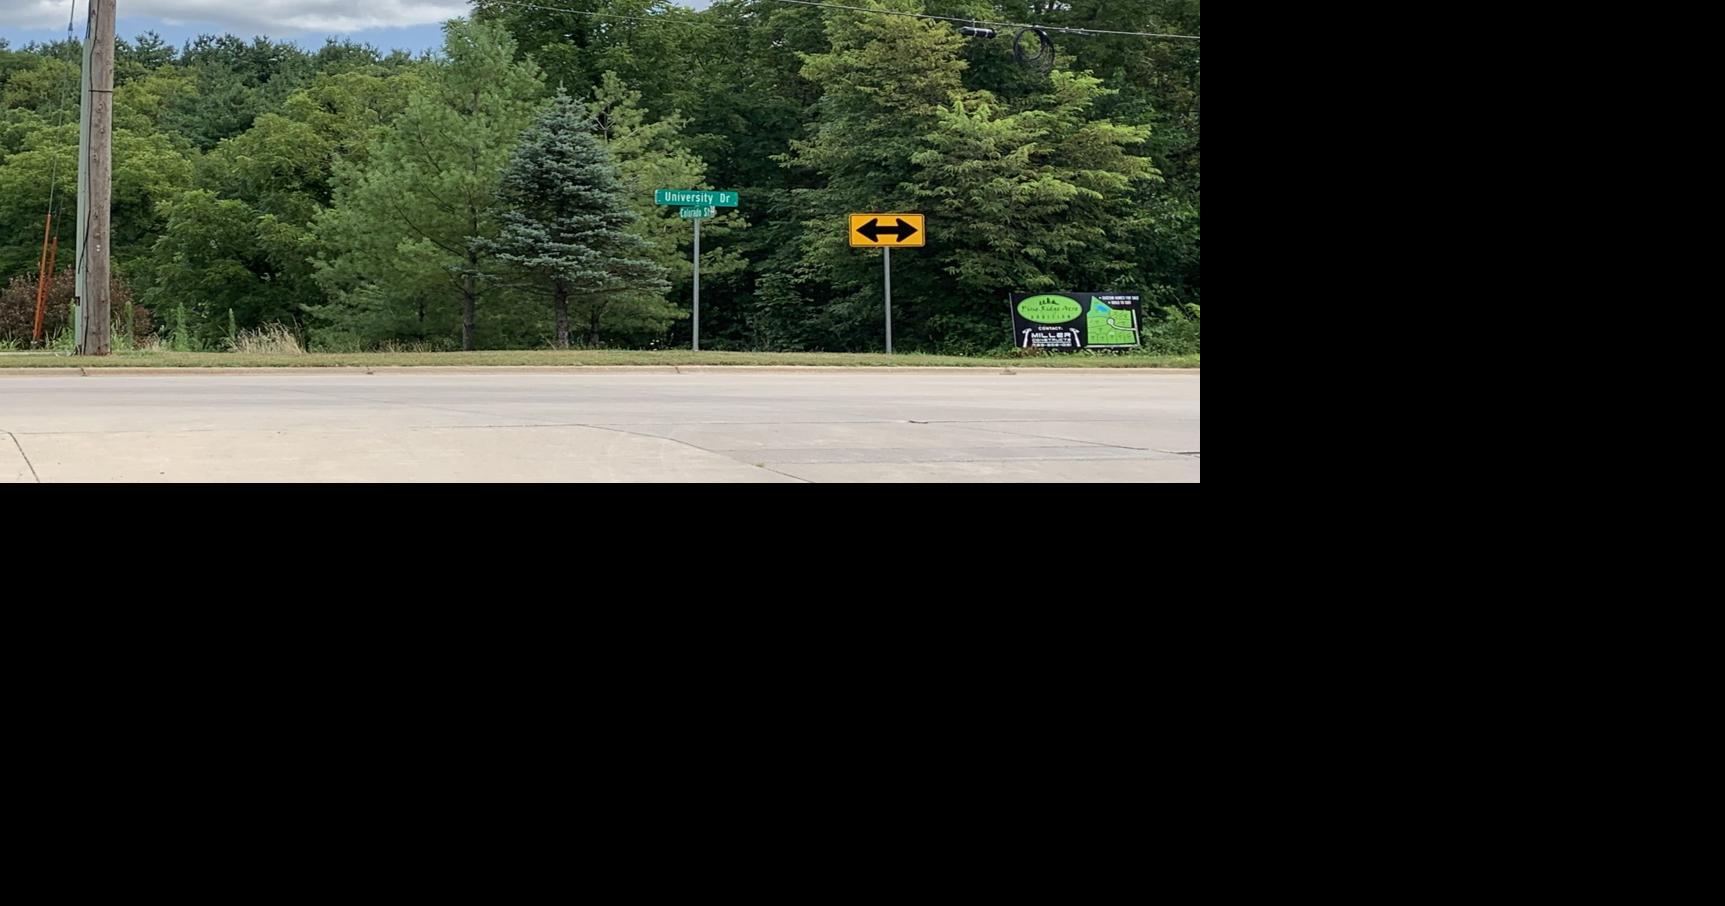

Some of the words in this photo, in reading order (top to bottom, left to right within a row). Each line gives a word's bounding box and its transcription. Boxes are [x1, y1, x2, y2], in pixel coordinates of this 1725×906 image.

[664, 191, 714, 205] University
[719, 193, 731, 203] Dr
[680, 207, 702, 218] Colorado
